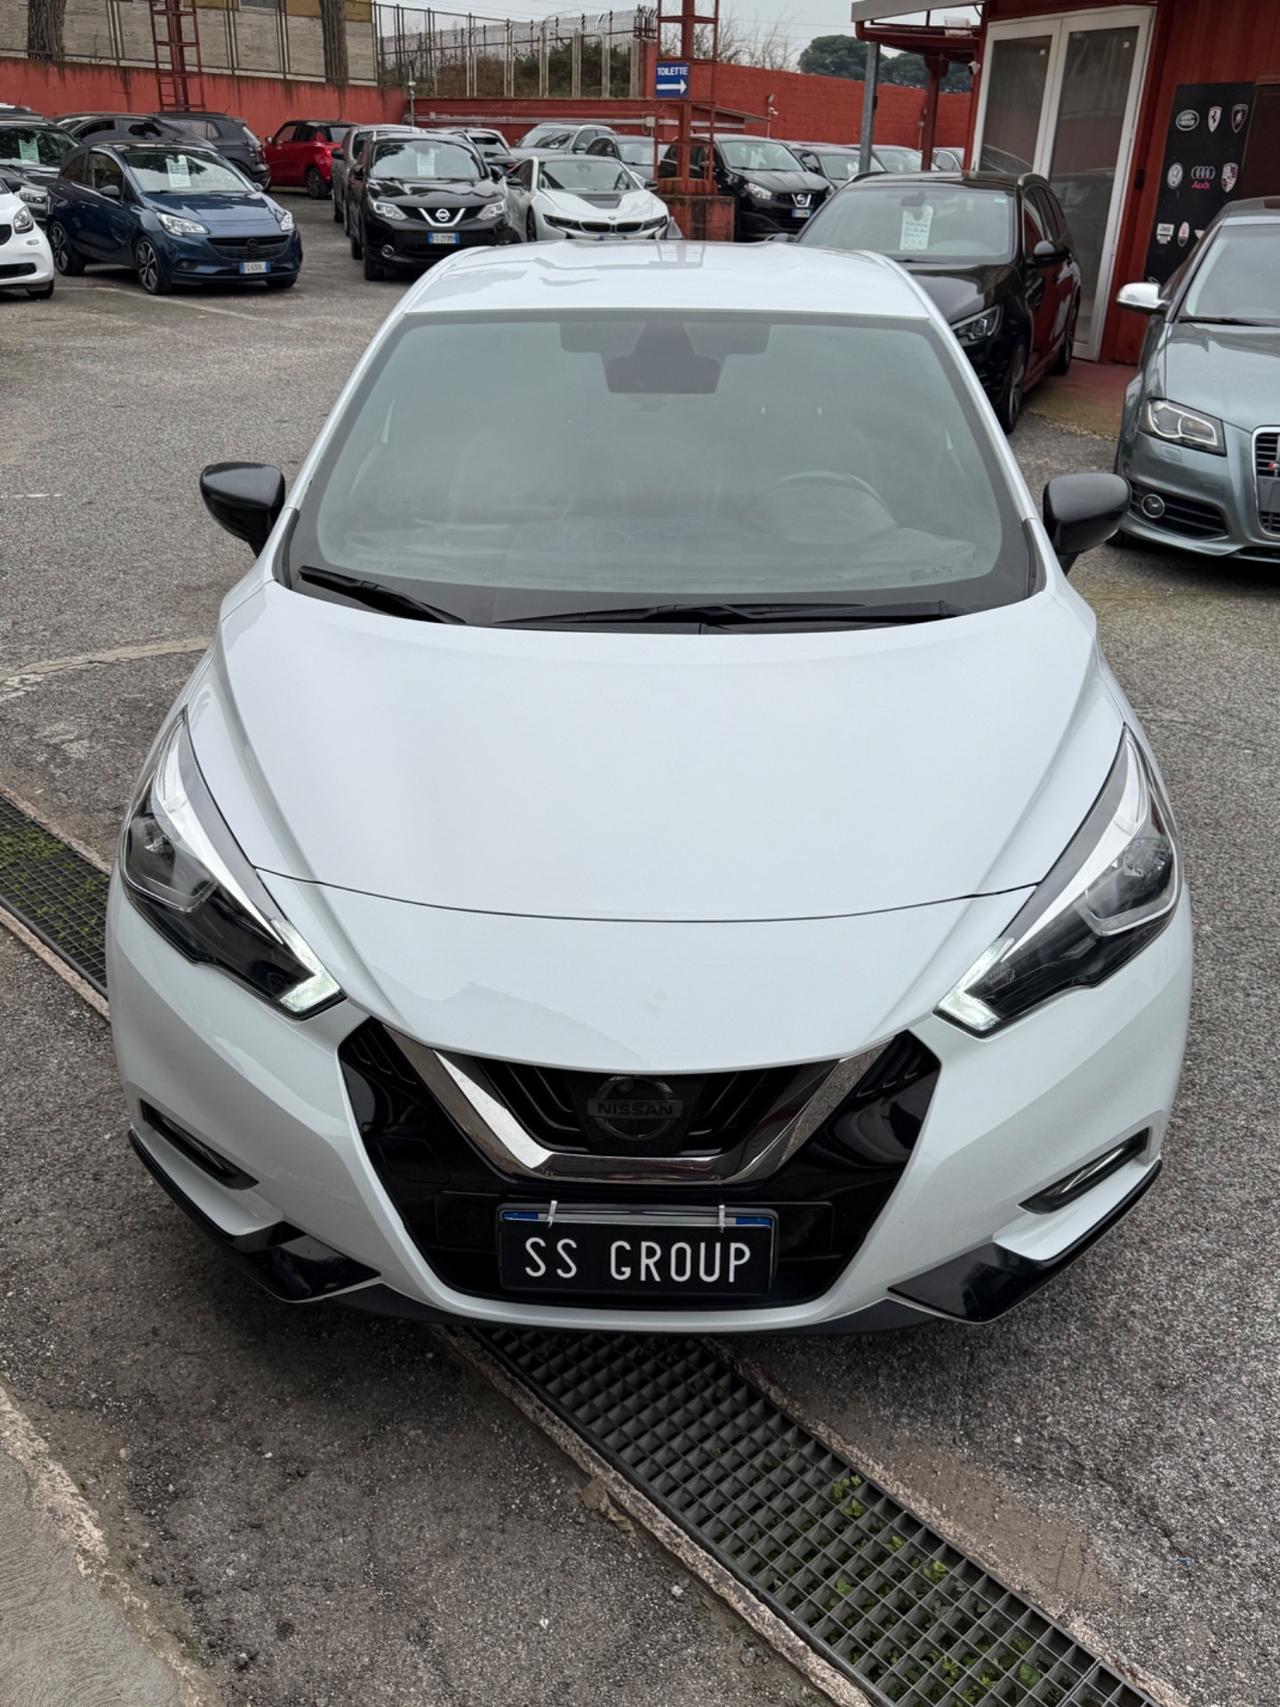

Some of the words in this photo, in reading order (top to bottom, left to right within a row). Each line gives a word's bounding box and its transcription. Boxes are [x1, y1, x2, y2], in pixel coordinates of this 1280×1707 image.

[657, 66, 689, 76] TOILETTE
[1191, 181, 1211, 190] Audi
[597, 1102, 674, 1116] NISSAN
[525, 1237, 578, 1279] SS
[610, 1240, 751, 1283] GROUP
